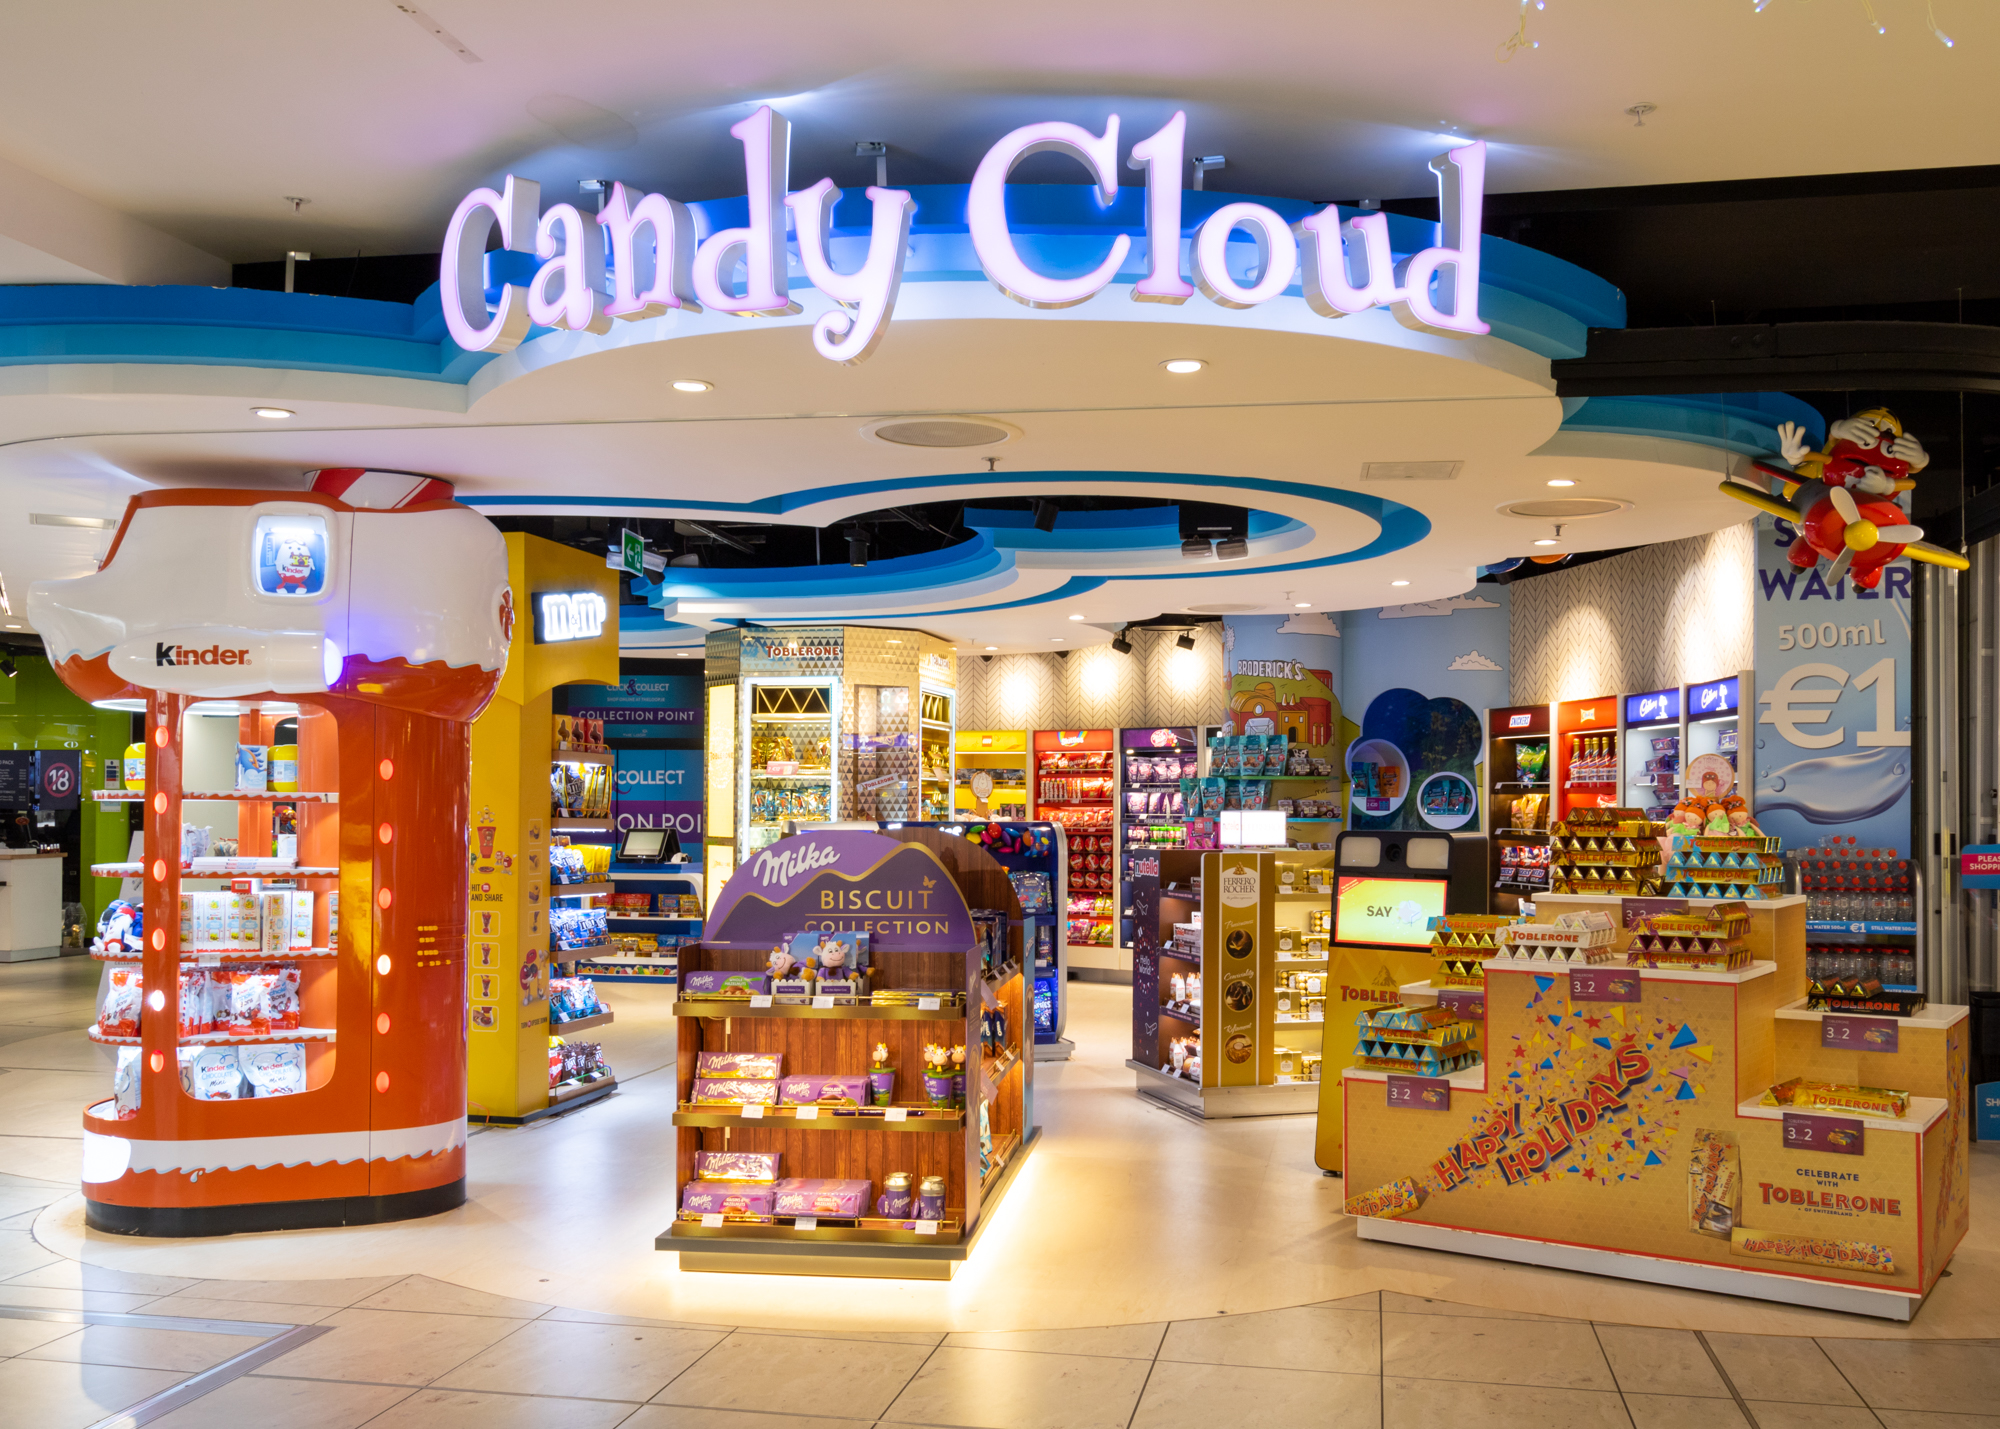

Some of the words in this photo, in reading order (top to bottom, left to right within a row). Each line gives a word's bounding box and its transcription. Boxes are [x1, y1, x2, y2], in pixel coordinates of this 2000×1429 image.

[440, 105, 914, 363] Candy
[968, 110, 1491, 337] Cloud
[1778, 619, 1886, 650] 500ml
[1237, 659, 1305, 680] BRODERICK'S
[635, 683, 670, 691] COLLECT
[1758, 658, 1911, 749] €1
[579, 710, 654, 721] COLLECTION
[657, 711, 695, 721] POINT
[1510, 714, 1531, 727] SNICKERS
[49, 769, 69, 791] 18
[614, 770, 685, 785] COLLECT
[1689, 838, 1756, 848] TOBLERONE
[753, 841, 841, 887] Milka
[1566, 853, 1628, 862] TOBLERONE
[1135, 857, 1159, 877] nutella
[1682, 869, 1750, 879] TOBLERONE
[1223, 877, 1256, 886] FERRERO
[1568, 881, 1630, 891] TOBLERONE
[1223, 885, 1255, 893] ROCHER
[484, 893, 504, 902] SHARE
[821, 890, 934, 910] BISCUIT
[1367, 905, 1392, 917] SAY
[804, 920, 949, 935] COLLECTION
[1646, 921, 1718, 933] TOBLERONE
[1850, 922, 1866, 933] €1
[1512, 931, 1580, 943] TOBLERONE
[1646, 952, 1718, 965] TOBLERONE
[1573, 981, 1580, 992] 3
[1588, 981, 1595, 992] 2
[1341, 985, 1401, 1004] TOBLER
[1826, 998, 1900, 1012] TOBLERONE
[1826, 1027, 1834, 1038] 3
[1842, 1028, 1850, 1040] 2
[1391, 1088, 1398, 1099] 3
[1404, 1088, 1411, 1100] 2
[1812, 1093, 1889, 1112] TOBLERONE
[1985, 1098, 2000, 1107] SH
[1788, 1127, 1796, 1139] 3
[1804, 1129, 1812, 1141] 2
[1431, 1103, 1525, 1192] HAPPY
[1796, 1168, 1860, 1182] CELEBRATE
[1816, 1180, 1839, 1188] WITH
[1758, 1182, 1902, 1216] TOBLERONE
[1813, 1208, 1853, 1217] SWITZERLAND
[1743, 1238, 1795, 1255] HAPPY
